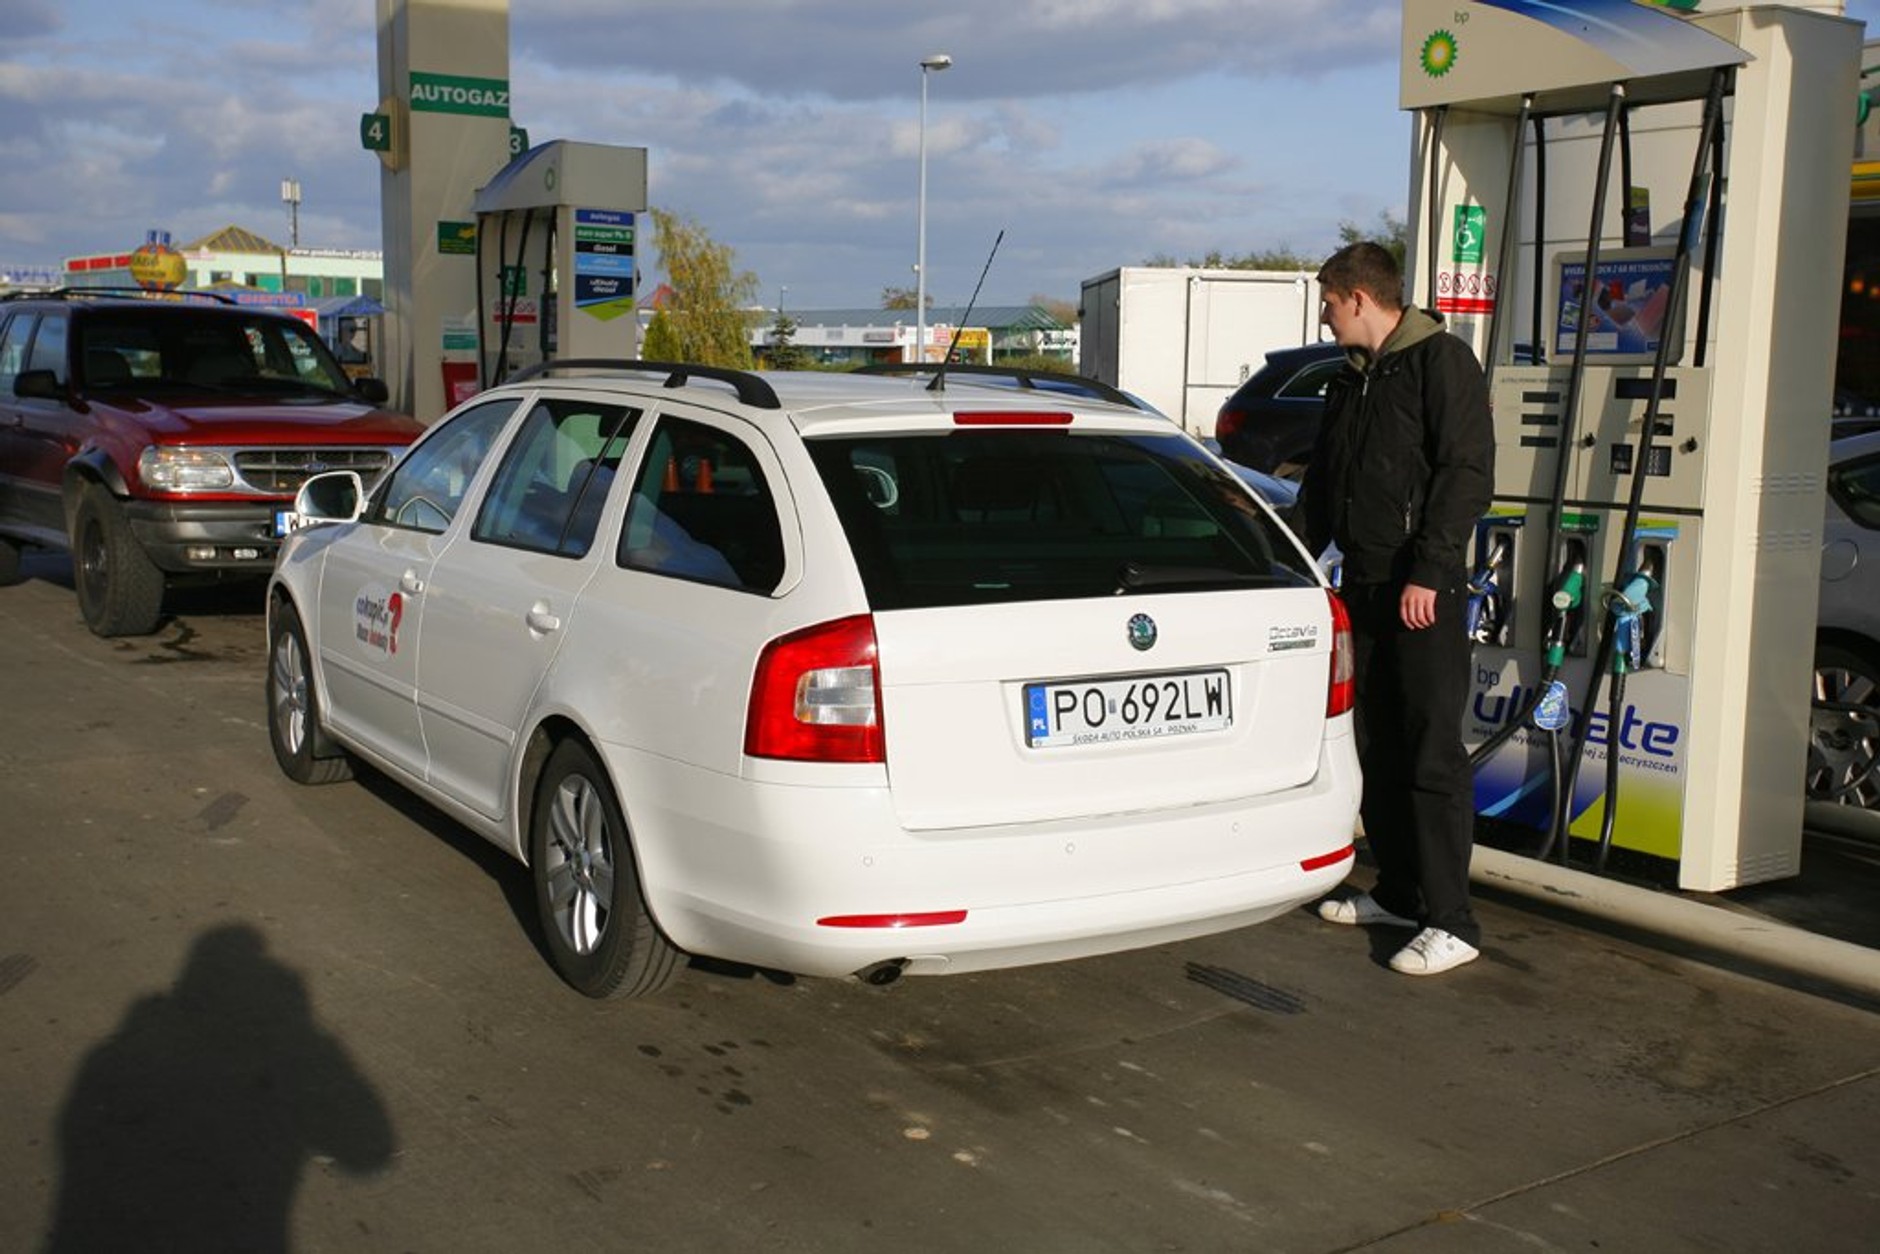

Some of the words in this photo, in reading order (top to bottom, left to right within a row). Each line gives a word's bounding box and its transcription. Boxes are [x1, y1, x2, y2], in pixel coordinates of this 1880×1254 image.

[1454, 10, 1470, 25] bp
[410, 83, 509, 107] AUTOGAZ
[367, 121, 383, 141] 4
[510, 134, 521, 154] 3
[1268, 624, 1318, 640] Octavia
[1477, 665, 1499, 687] bp
[1054, 688, 1107, 732] PO
[1121, 676, 1222, 724] 692LW
[1032, 718, 1046, 731] PL
